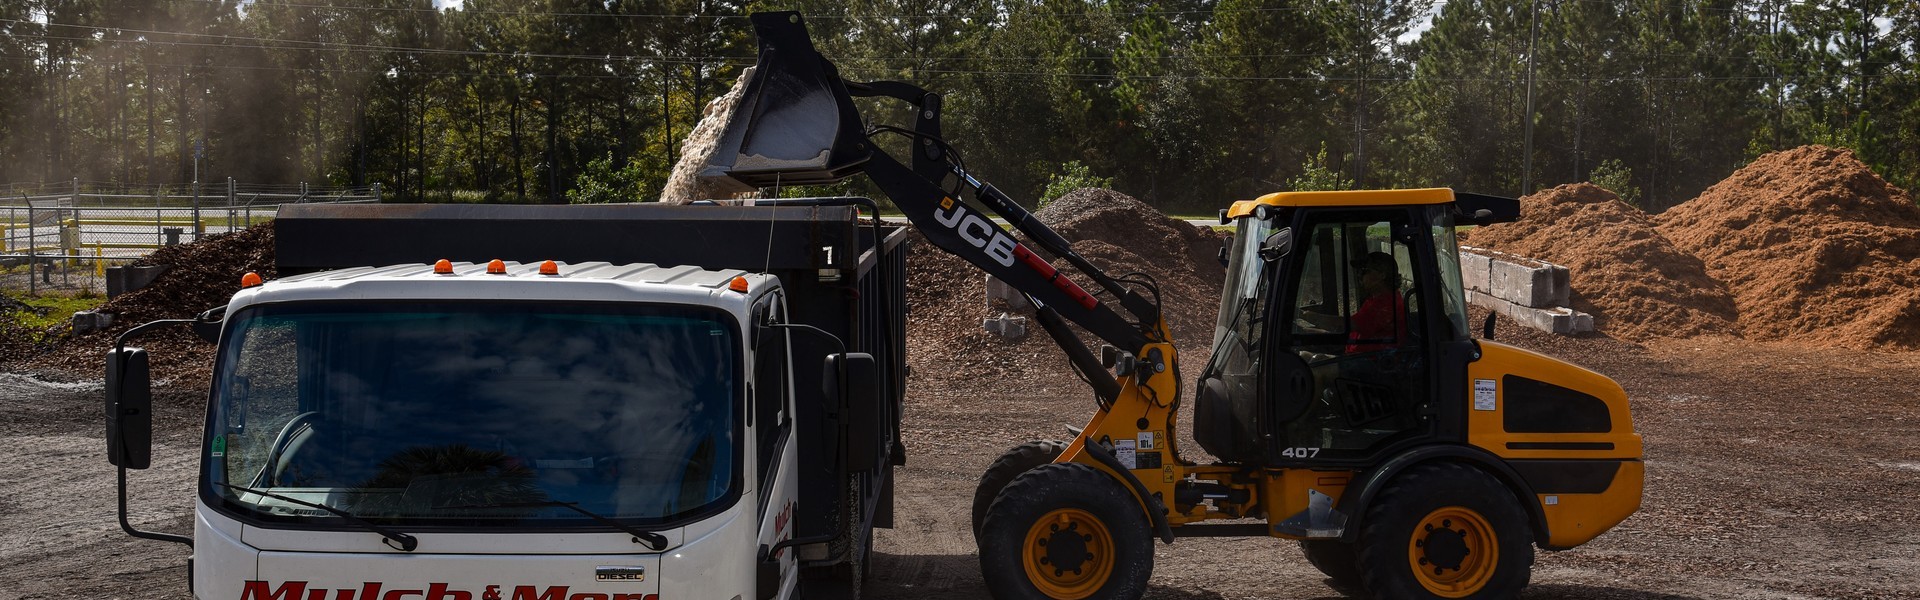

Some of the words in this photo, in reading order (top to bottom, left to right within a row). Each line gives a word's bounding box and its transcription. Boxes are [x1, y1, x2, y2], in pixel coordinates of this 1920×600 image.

[934, 205, 1015, 267] JCB
[1282, 447, 1320, 458] 407
[510, 585, 658, 600] Mor
